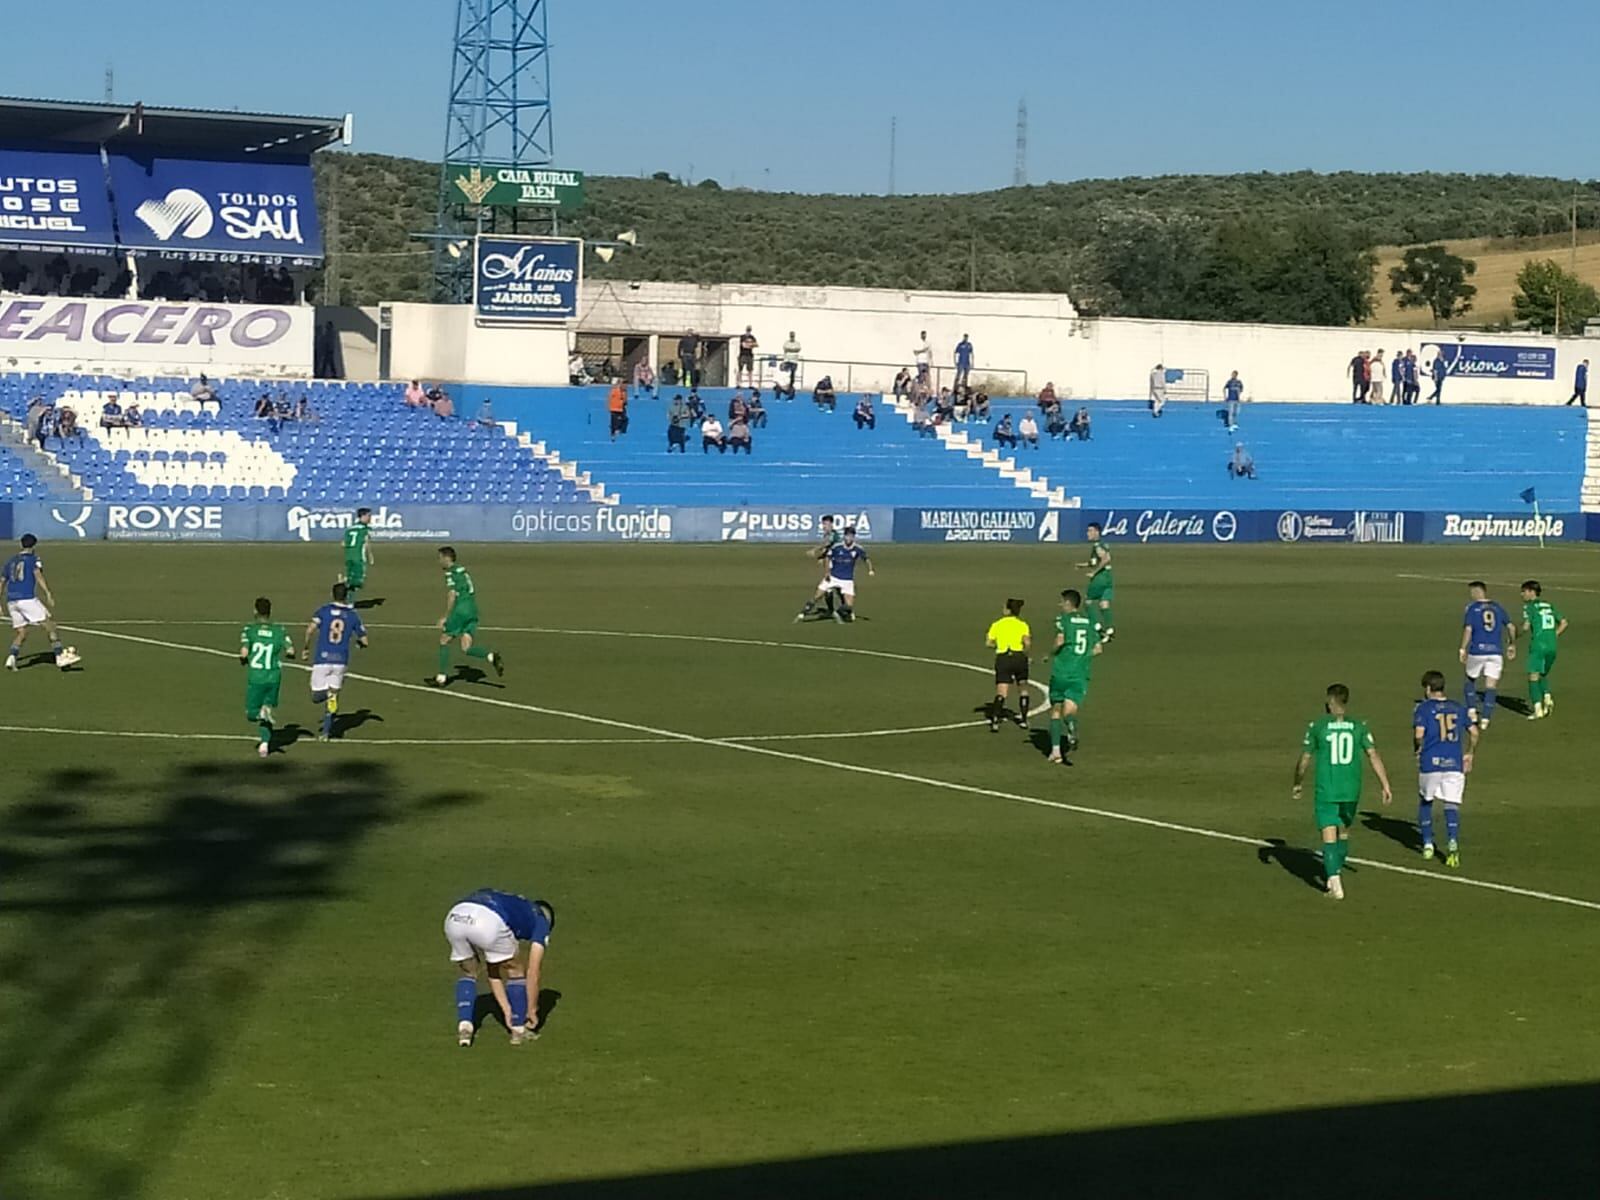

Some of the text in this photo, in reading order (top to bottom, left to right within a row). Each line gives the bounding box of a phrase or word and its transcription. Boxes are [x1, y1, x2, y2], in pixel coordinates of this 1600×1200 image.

[532, 171, 579, 186] RURAL
[217, 192, 298, 207] TOLDOS
[220, 206, 304, 244] SAU
[491, 292, 562, 305] JAMONES
[108, 505, 223, 529] ROYSE
[511, 510, 592, 537] ópticas
[749, 514, 813, 530] PLUSS
[920, 511, 1036, 529] MARIANO GALIANO
[1101, 510, 1128, 536] La
[1443, 514, 1564, 541] Rapimueble
[328, 618, 345, 644] 8
[1483, 610, 1496, 632] 9
[1074, 629, 1087, 655] 5
[250, 642, 274, 670] 21
[1435, 713, 1459, 742] 15
[1326, 731, 1354, 765] 10
